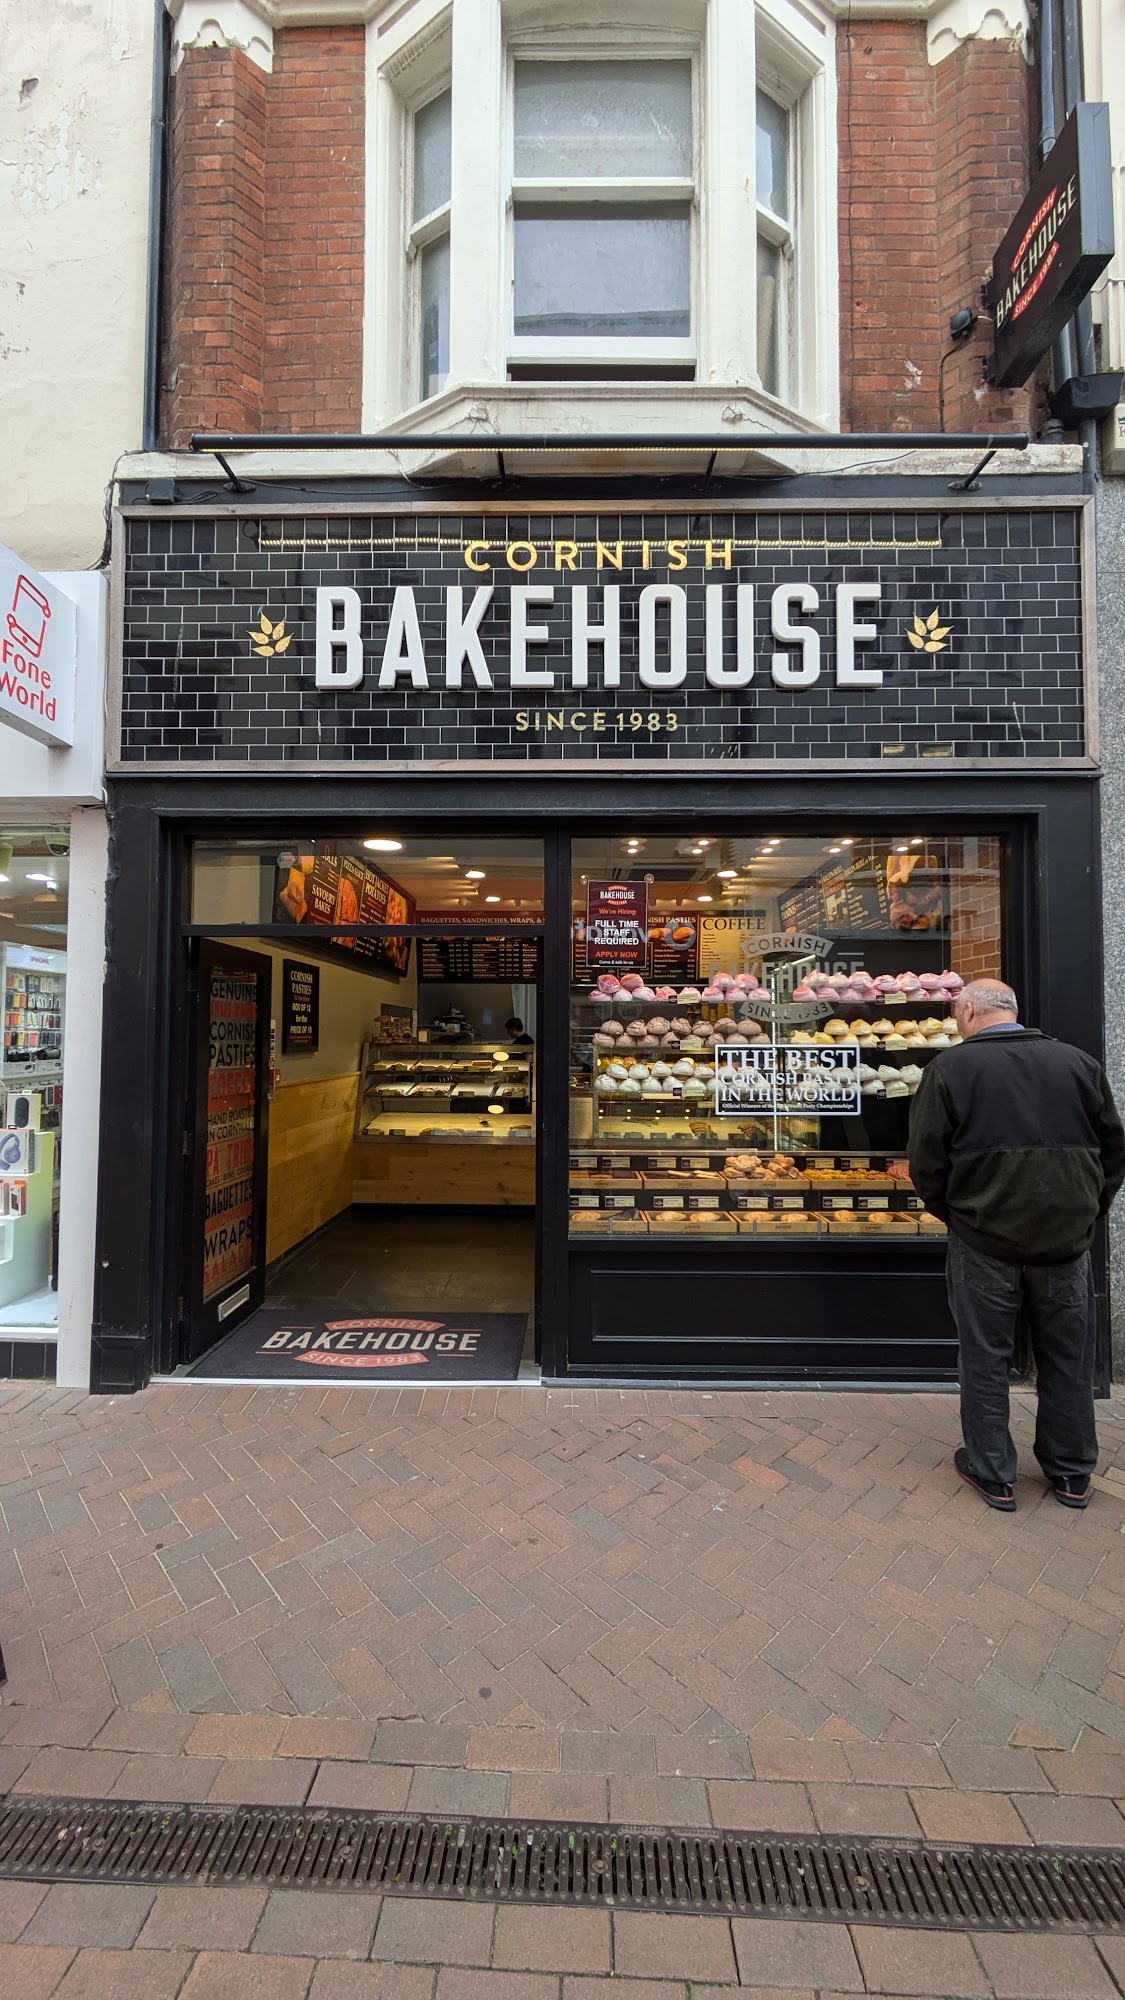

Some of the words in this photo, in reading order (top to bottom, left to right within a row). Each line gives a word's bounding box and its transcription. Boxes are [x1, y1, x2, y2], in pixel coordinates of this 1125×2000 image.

[1014, 195, 1055, 267] CORNISH
[996, 174, 1077, 329] BAKEHOUSE
[1013, 281, 1038, 318] SINCE
[1038, 244, 1058, 283] 1983
[463, 539, 733, 572] CORNISH
[315, 583, 884, 691] BAKEHOUSE
[2, 638, 51, 690] Fone
[0, 670, 57, 722] World
[515, 712, 607, 732] SINCE
[616, 712, 680, 732] 1983
[312, 884, 337, 906] SAVOURY
[365, 882, 387, 905] POTATOES
[600, 891, 635, 899] BAKEHOUSE
[314, 898, 331, 915] BAKES
[617, 908, 636, 916] Hiring
[595, 920, 617, 928] FULL
[619, 920, 639, 928] TIME
[603, 928, 630, 936] STAFF
[702, 918, 766, 930] COFFEE
[594, 937, 639, 946] REQUIRED
[747, 936, 827, 955] CORNISH
[290, 970, 313, 983] CORNISH
[211, 978, 257, 1002] GENUINE
[291, 983, 312, 995] PASTIES
[748, 1003, 792, 1020] SIN
[210, 1021, 257, 1041] CORNISH
[209, 1044, 256, 1067] PASTIES
[721, 1050, 778, 1070] THE
[785, 1050, 854, 1070] BEST
[721, 1072, 799, 1085] CORNISH
[802, 1073, 853, 1085] PASTY
[721, 1088, 746, 1101] IN
[748, 1088, 785, 1102] THE
[786, 1088, 855, 1102] WORLD
[205, 1179, 253, 1220] BAGUETTES
[204, 1215, 253, 1263] WRAPS
[333, 1319, 434, 1331] CORNISH
[262, 1332, 481, 1351] BAKEHOUSE
[303, 1352, 367, 1366] SINCE
[375, 1352, 422, 1366] 1983
